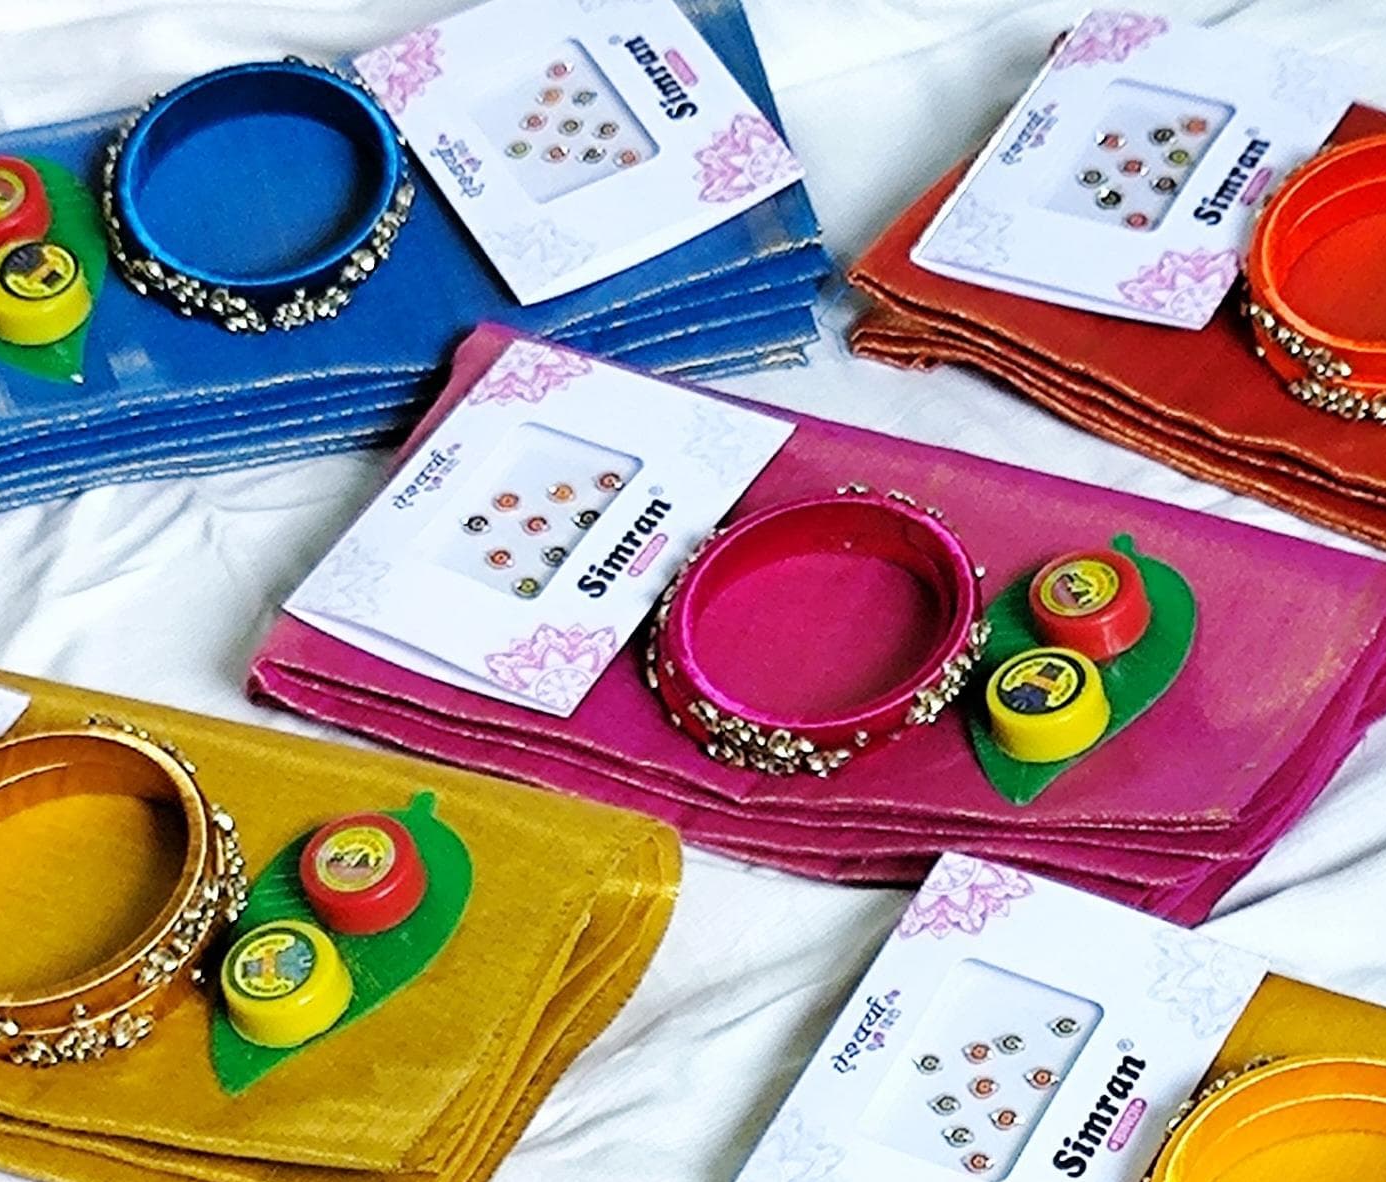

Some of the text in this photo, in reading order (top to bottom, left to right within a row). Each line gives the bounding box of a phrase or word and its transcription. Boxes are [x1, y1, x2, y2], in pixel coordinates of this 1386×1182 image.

[624, 36, 698, 119] Simran
[1193, 139, 1270, 226] Simran
[577, 499, 671, 598] Simran
[1052, 1055, 1146, 1178] Simran
